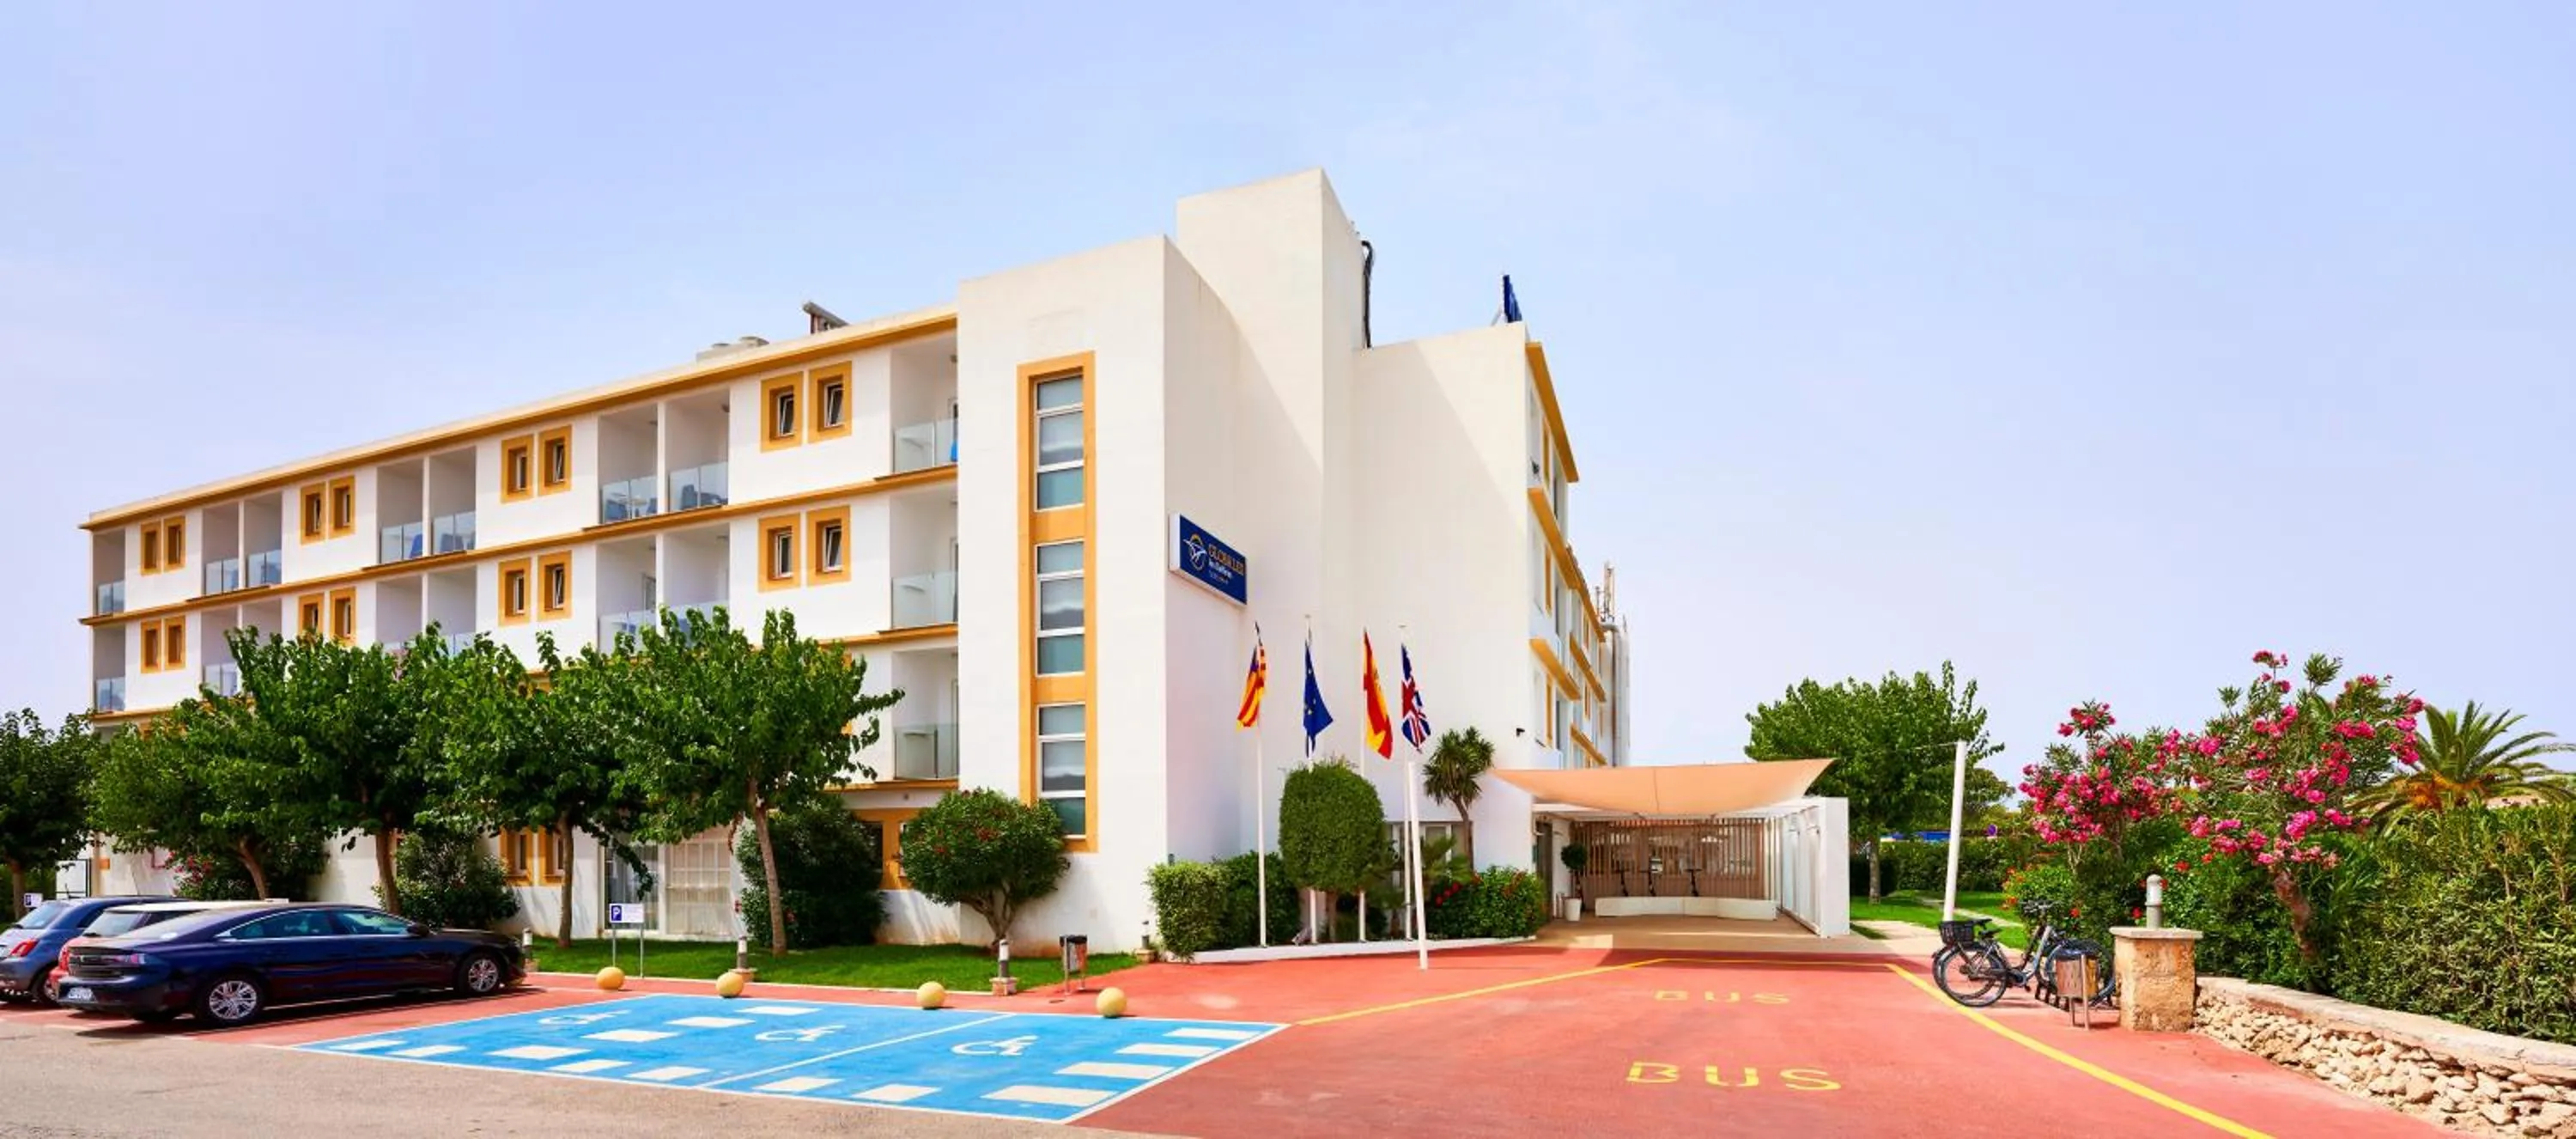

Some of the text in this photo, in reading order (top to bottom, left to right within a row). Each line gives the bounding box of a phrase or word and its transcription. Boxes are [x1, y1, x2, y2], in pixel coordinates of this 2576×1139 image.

[613, 906, 620, 920] P
[1654, 990, 1790, 1004] BUS
[1626, 1062, 1842, 1090] BUS
